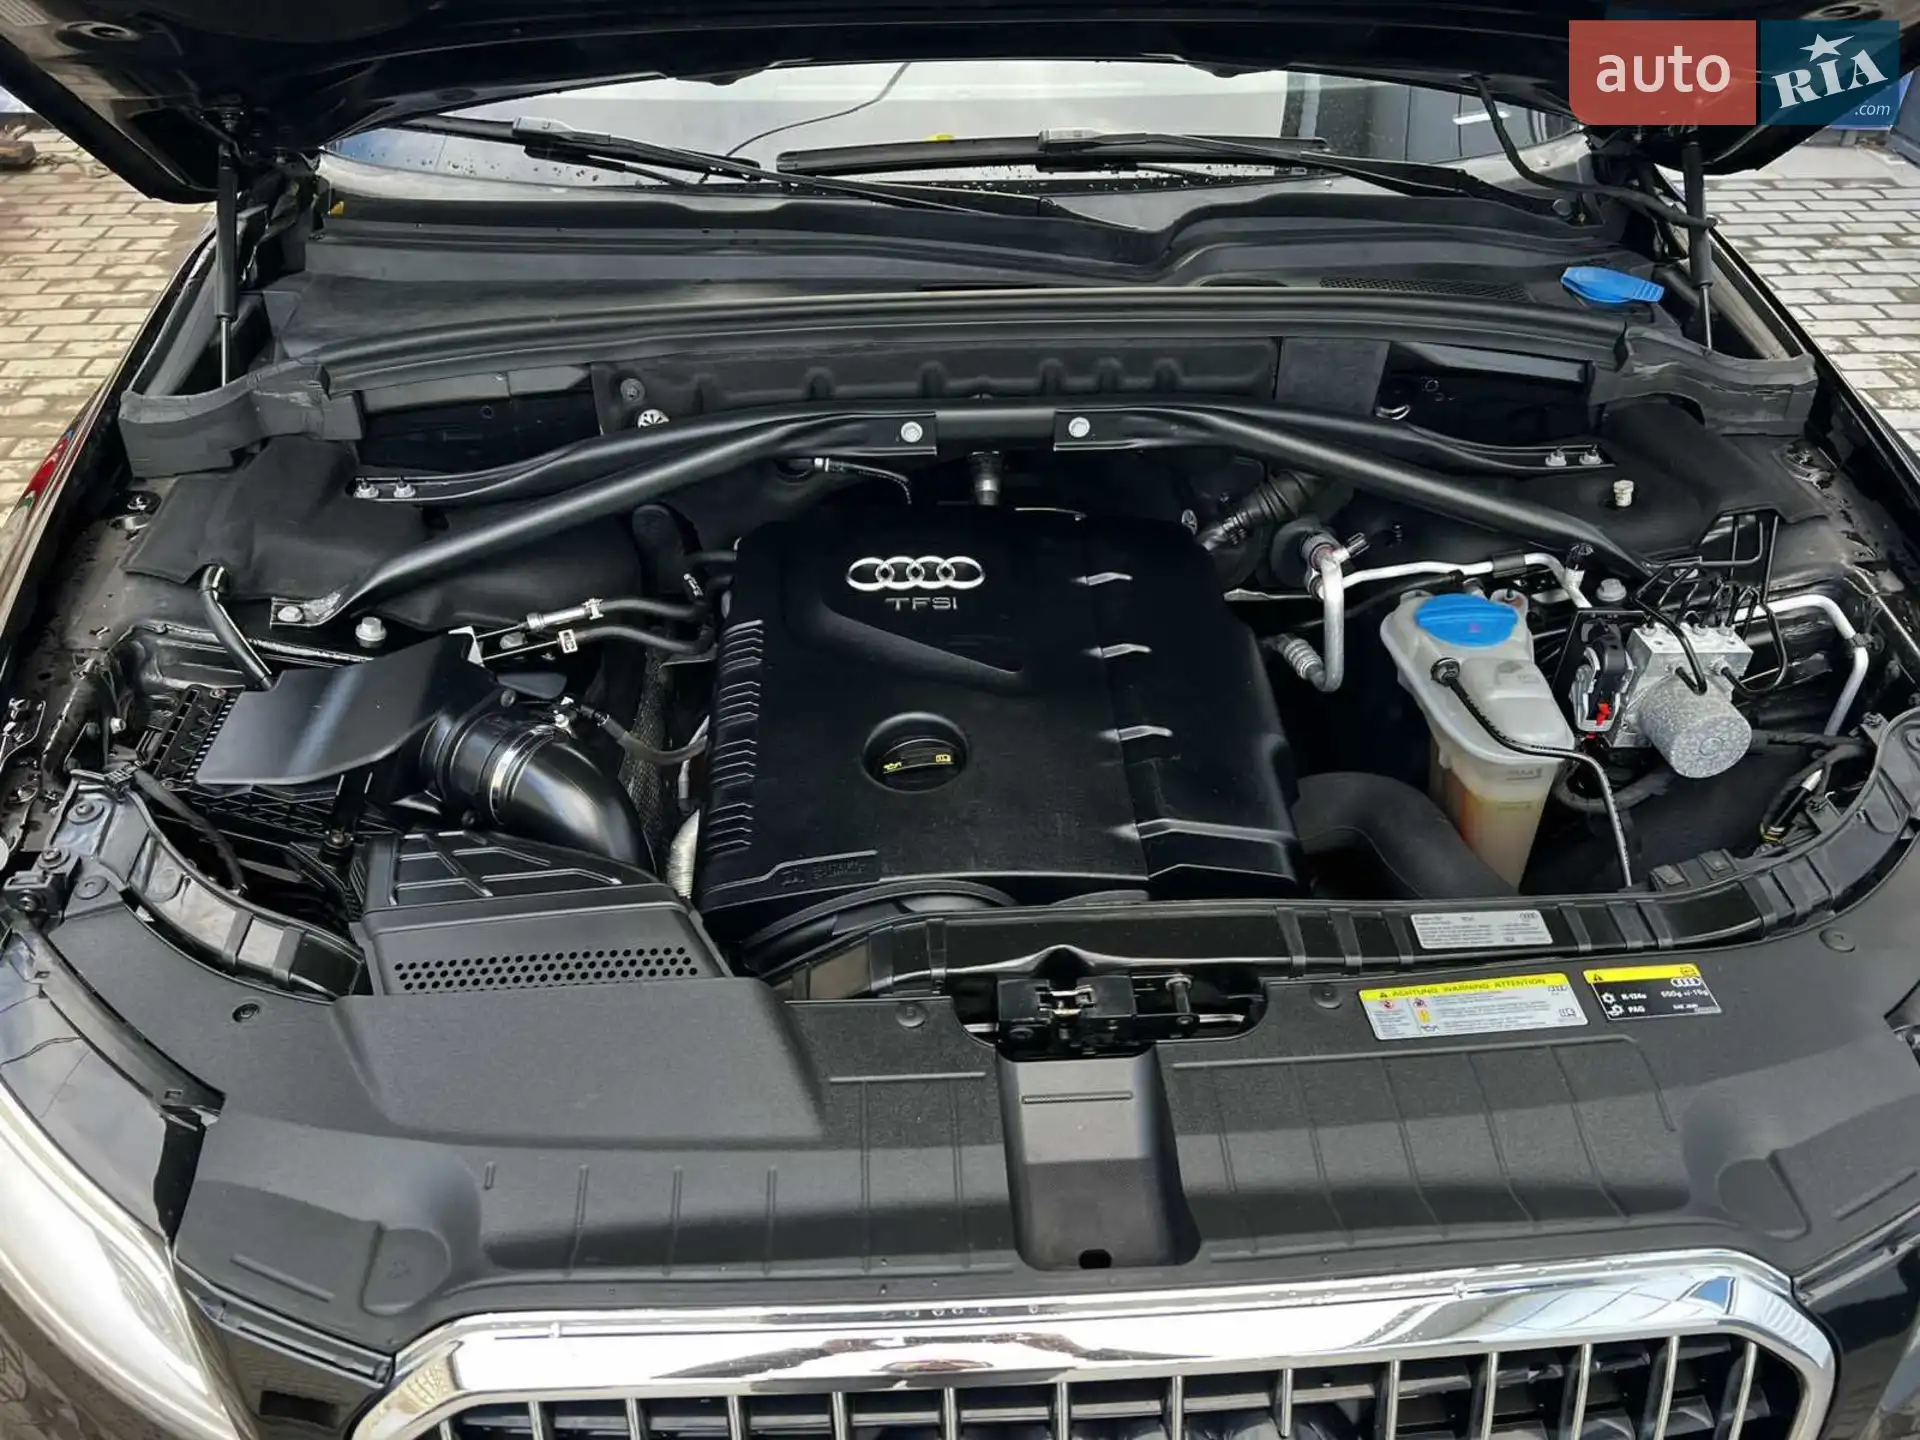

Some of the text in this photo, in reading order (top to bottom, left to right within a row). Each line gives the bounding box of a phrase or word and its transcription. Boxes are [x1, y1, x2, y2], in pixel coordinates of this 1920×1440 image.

[884, 596, 958, 611] TFSI
[1392, 978, 1546, 997] ACHTUNG WARNING ATTENTION
